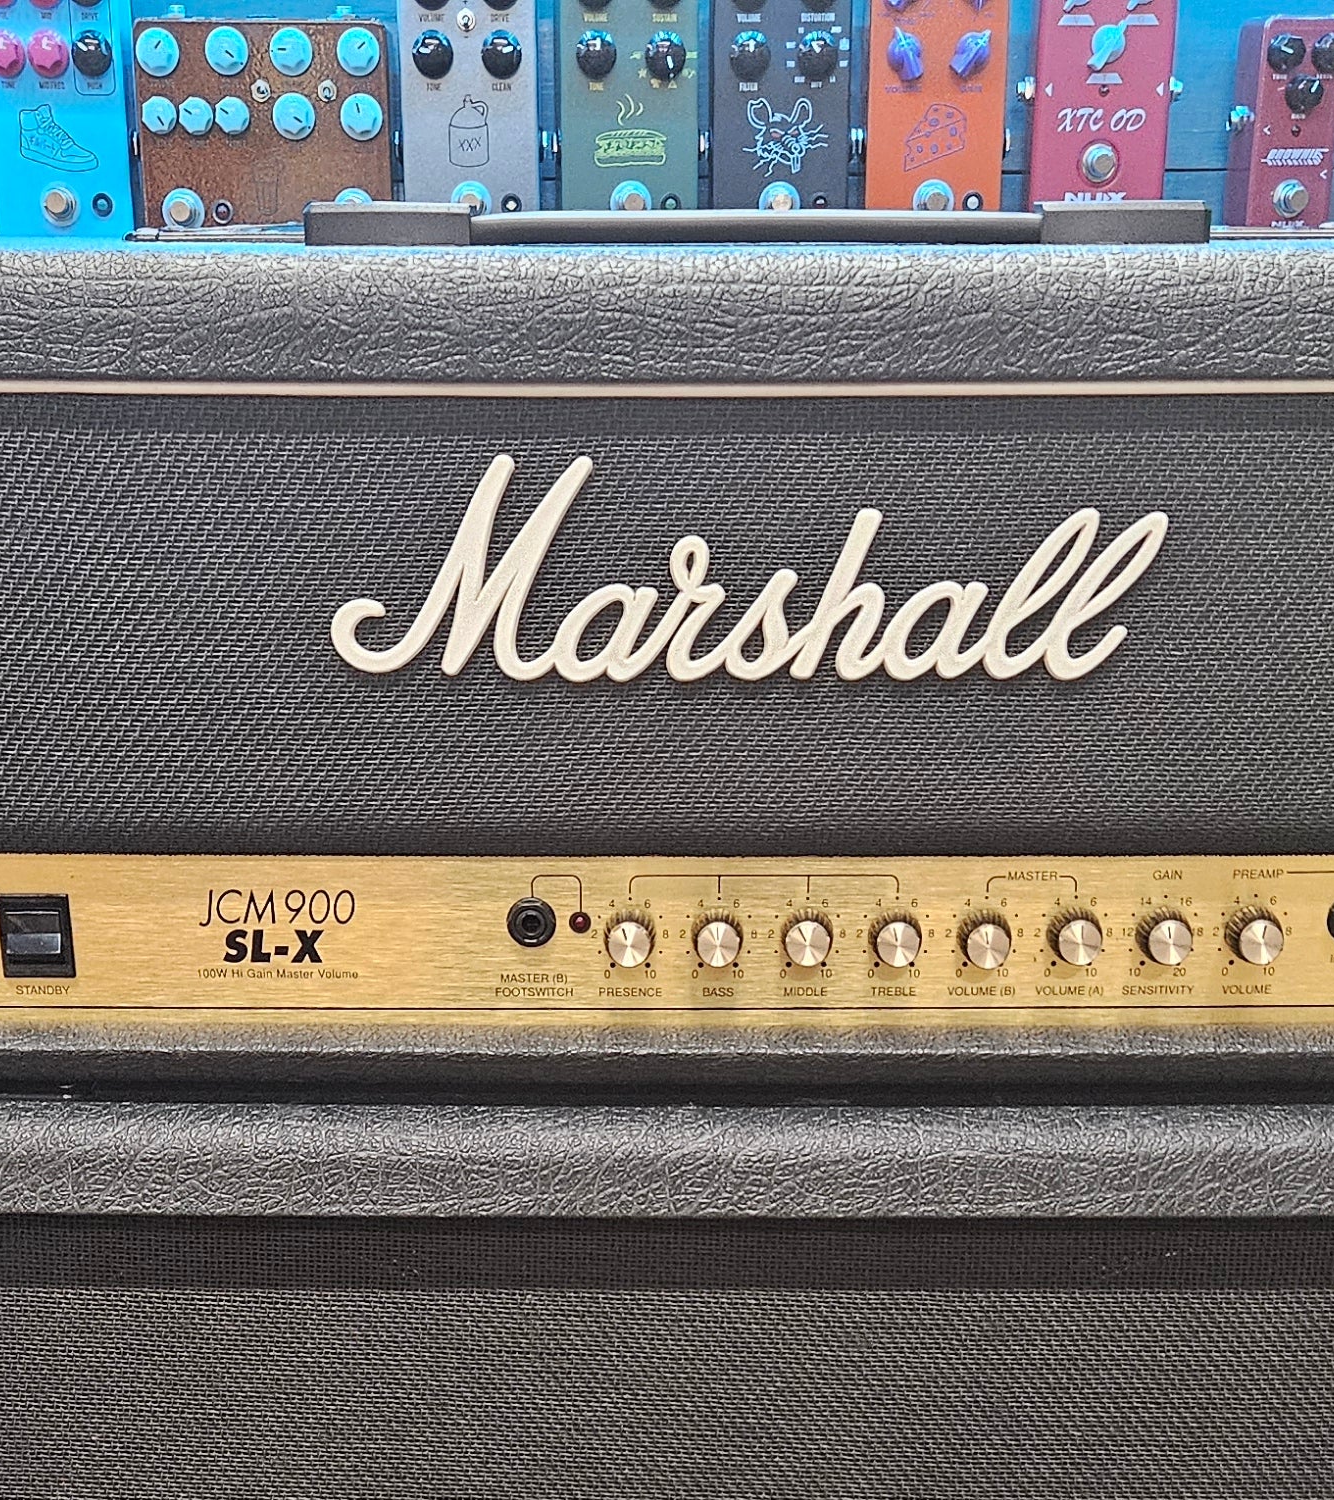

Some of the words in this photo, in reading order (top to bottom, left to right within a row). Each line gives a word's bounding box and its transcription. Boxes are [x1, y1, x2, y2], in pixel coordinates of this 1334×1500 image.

[1056, 107, 1104, 133] XTC
[1109, 108, 1147, 132] OD
[329, 453, 1169, 683] Marshall
[1007, 871, 1058, 881] MASTER
[1152, 870, 1183, 880] GAIN
[1232, 868, 1285, 880] PREAMP
[223, 929, 325, 963] SL-X
[197, 968, 228, 979] 100W
[231, 968, 244, 979] Hi
[247, 968, 273, 979] Gain
[276, 968, 314, 979] Master
[317, 968, 359, 979] Volume
[499, 973, 549, 984] MASTER
[551, 973, 569, 985] (B)
[14, 984, 71, 996] STANDBY
[494, 986, 574, 998] FOOTSWITCH
[598, 986, 663, 998] PRESENCE
[702, 987, 735, 997] BASS
[782, 987, 828, 997] MIDDLE
[870, 987, 917, 997] TREBLE
[947, 986, 997, 996] VOLUME
[999, 986, 1016, 997] (B)
[1035, 986, 1085, 996] VOLUME
[1088, 986, 1104, 997] (A)
[1121, 985, 1195, 996] SENSITIVITY
[1221, 984, 1273, 995] VOLUME
